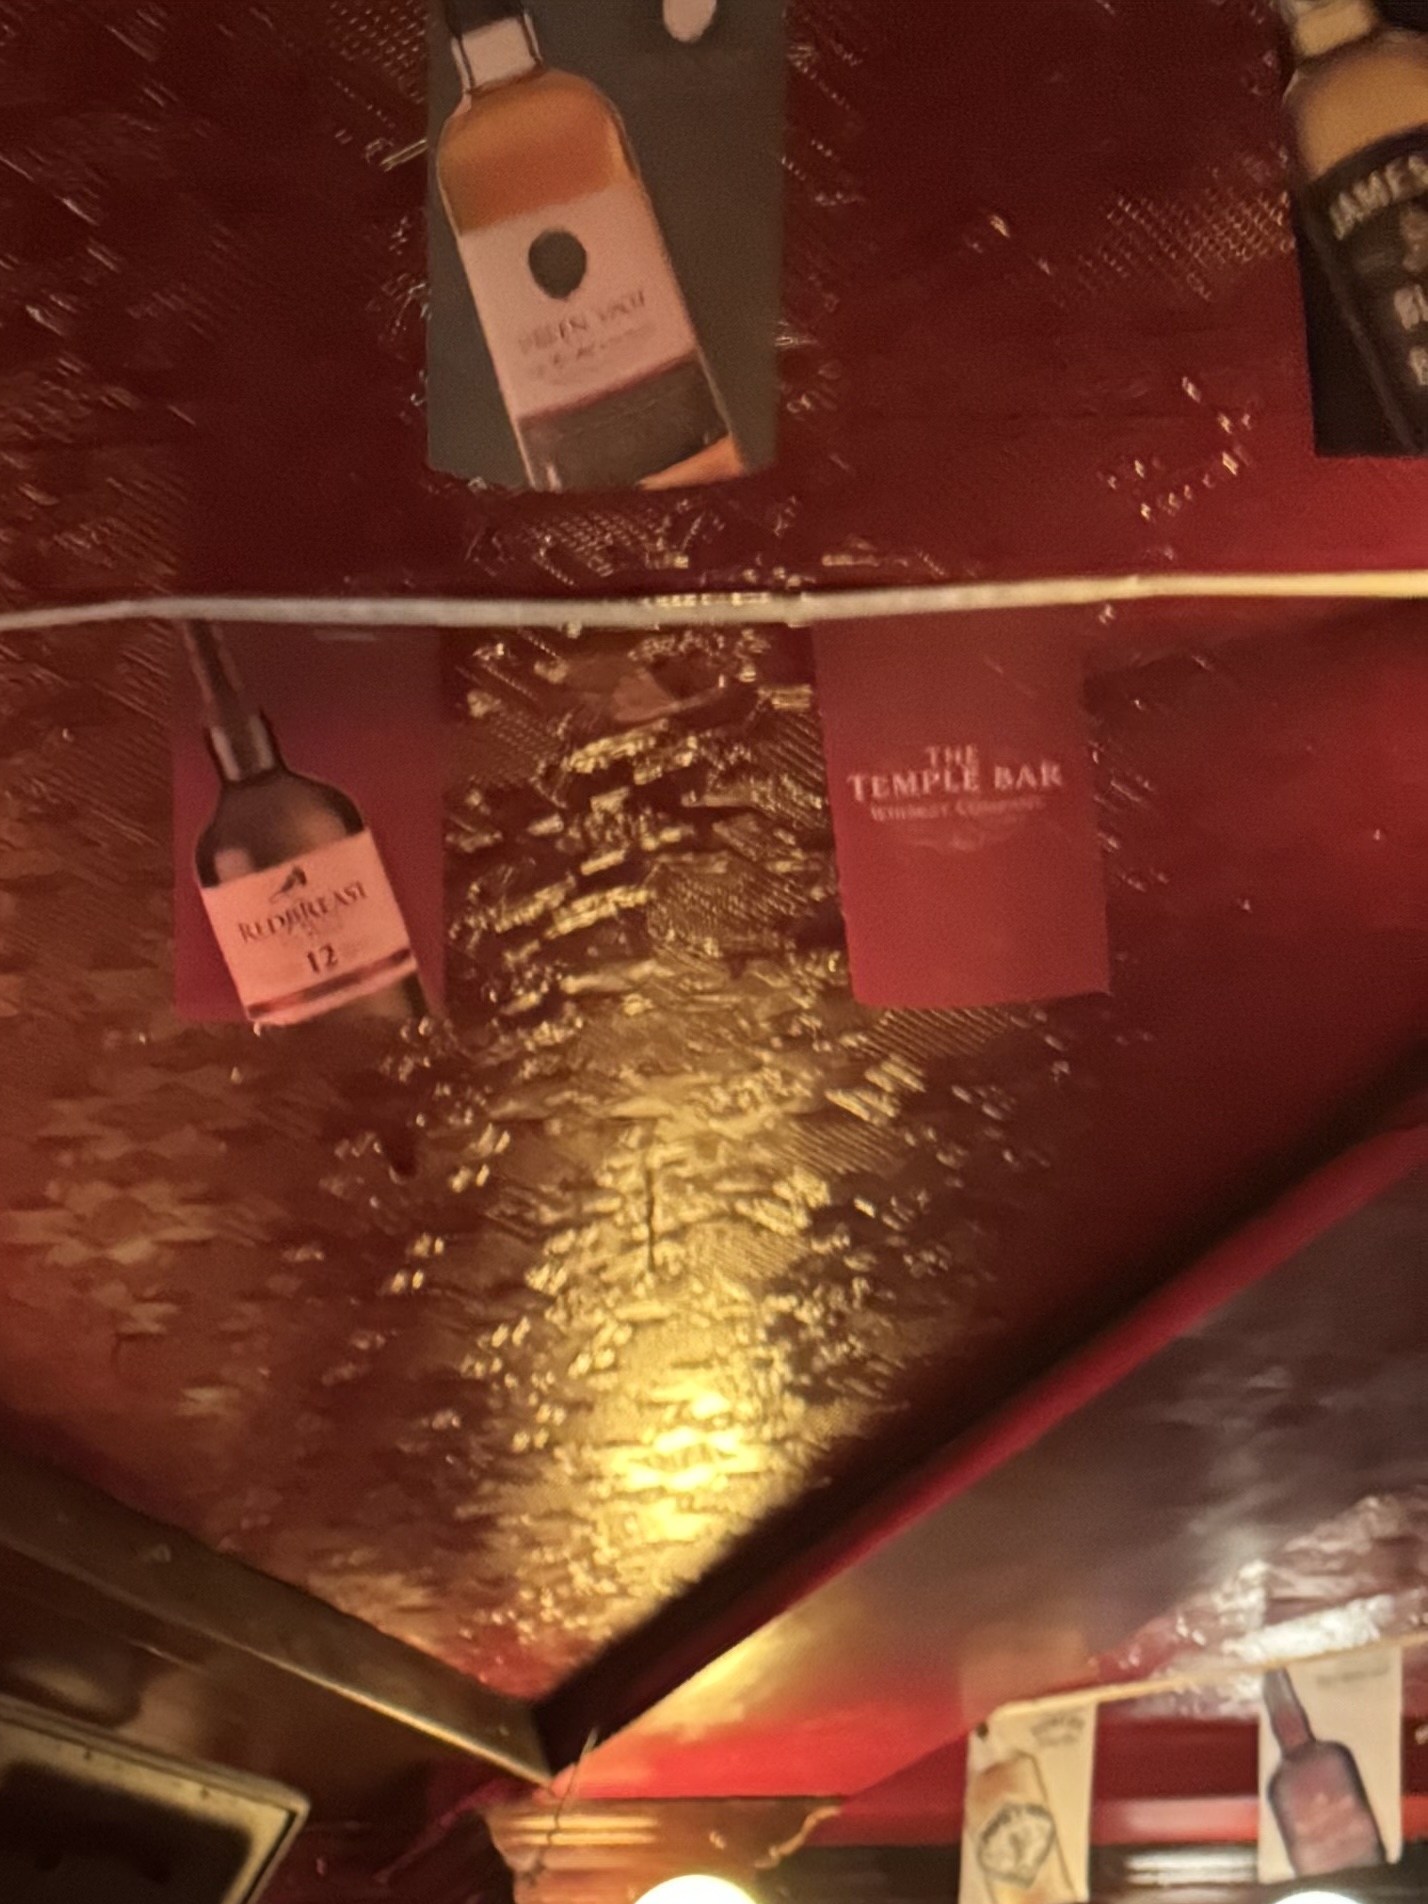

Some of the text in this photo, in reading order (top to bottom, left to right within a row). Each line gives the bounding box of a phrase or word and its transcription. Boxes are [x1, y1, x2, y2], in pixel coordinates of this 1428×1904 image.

[924, 743, 980, 767] THE
[846, 760, 1063, 803] TEMPLE BAR
[307, 943, 338, 975] 12
